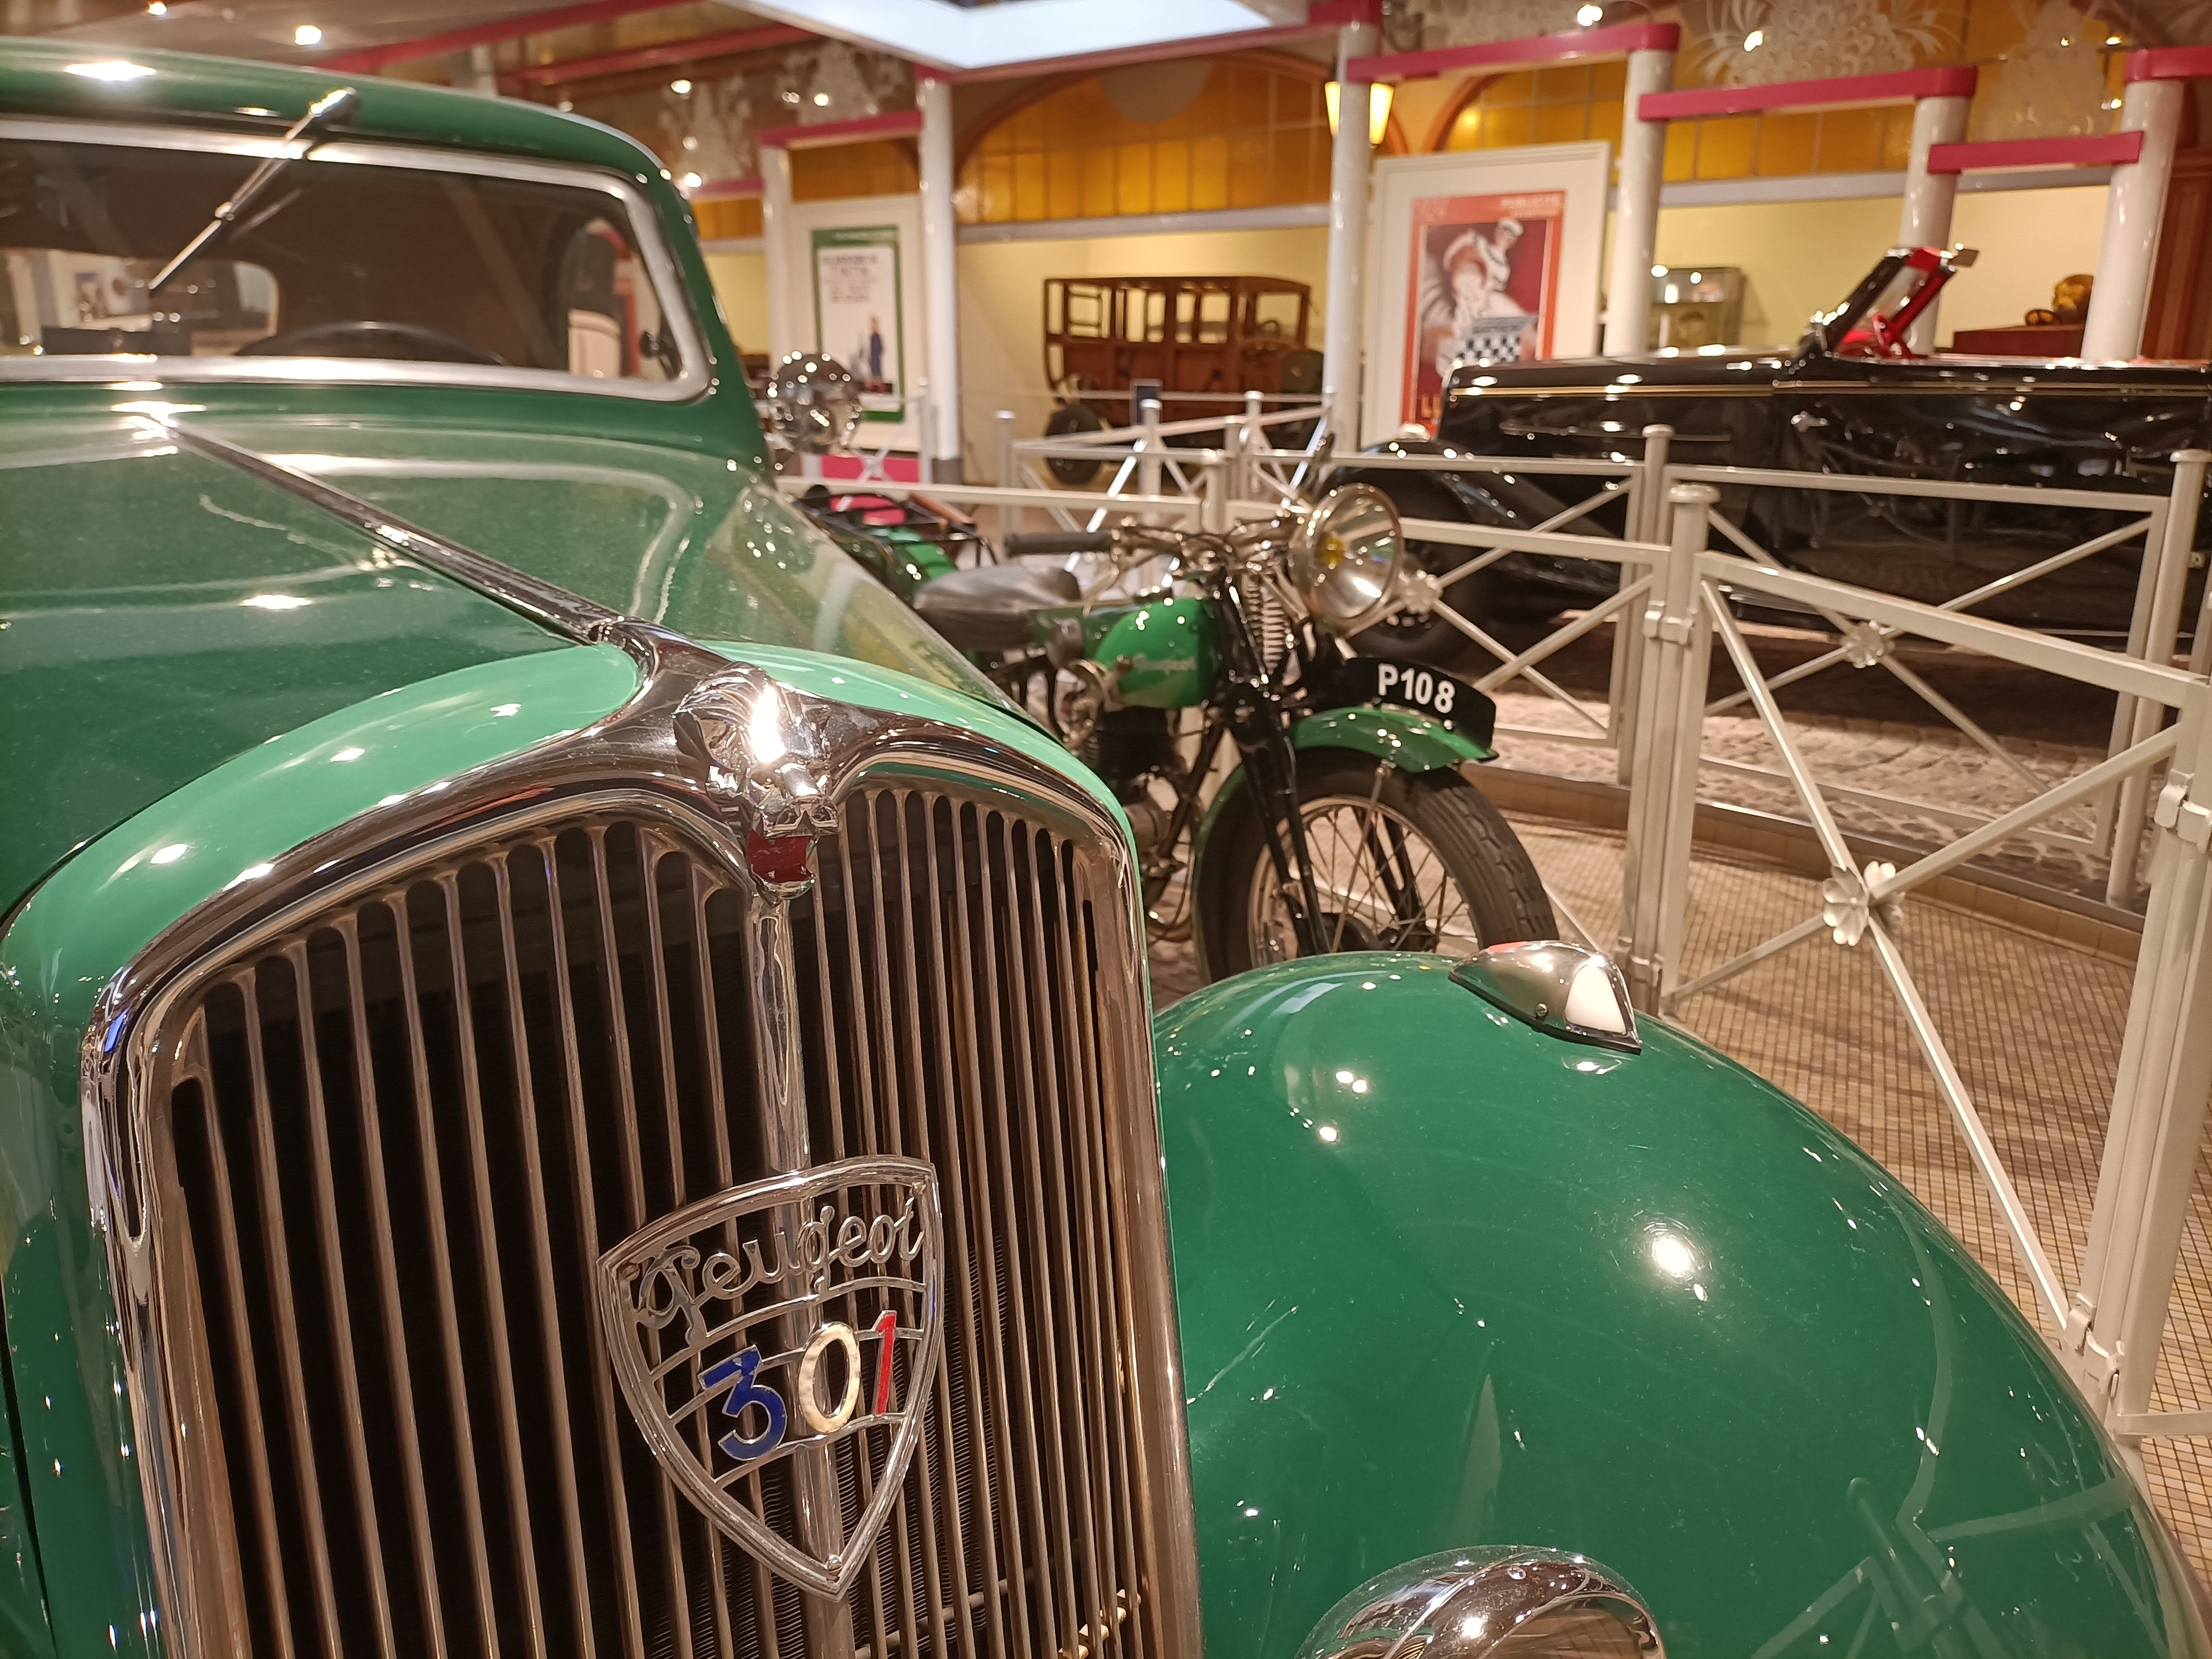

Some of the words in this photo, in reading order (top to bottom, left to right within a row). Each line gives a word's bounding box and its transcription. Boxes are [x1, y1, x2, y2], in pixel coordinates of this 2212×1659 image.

[1378, 663, 1455, 713] P108
[638, 1197, 925, 1346] Peugeot
[698, 1310, 897, 1461] 301
